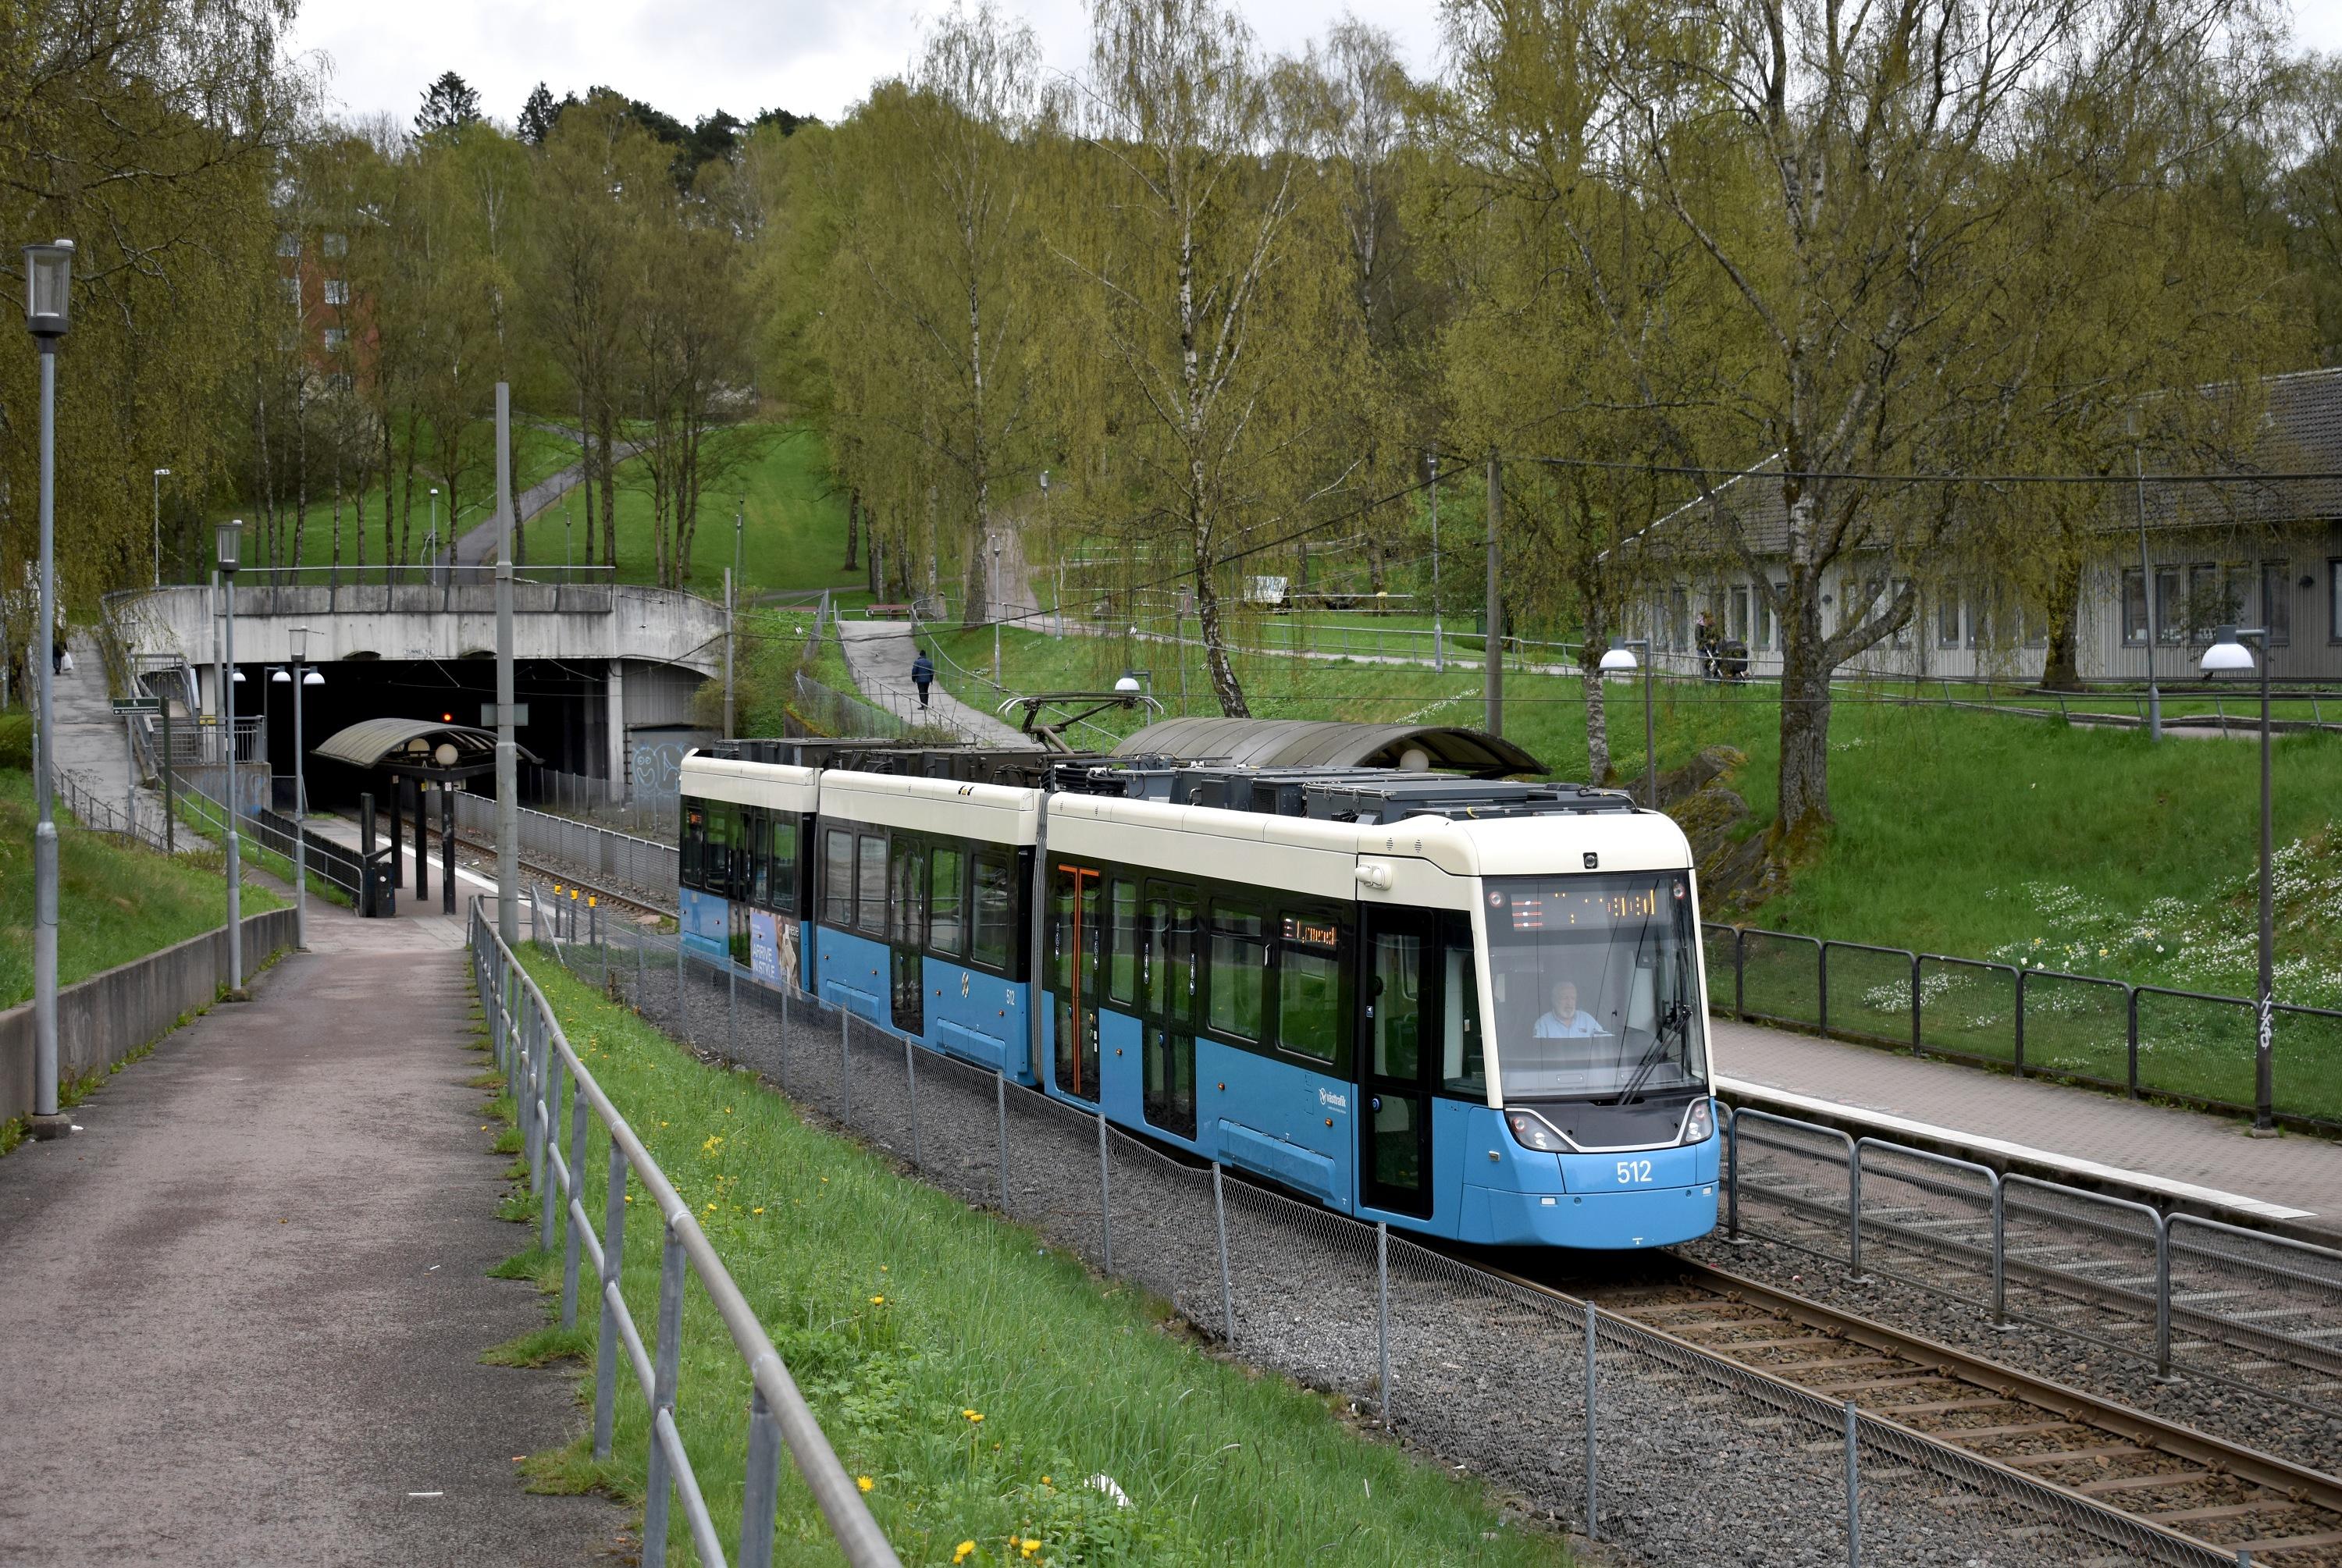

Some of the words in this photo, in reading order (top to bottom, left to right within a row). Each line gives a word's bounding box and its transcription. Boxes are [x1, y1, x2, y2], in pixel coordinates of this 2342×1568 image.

[753, 944, 772, 962] ARRIVE
[759, 962, 775, 979] STYLE
[1006, 988, 1015, 1005] 512
[1617, 1160, 1653, 1184] 512
